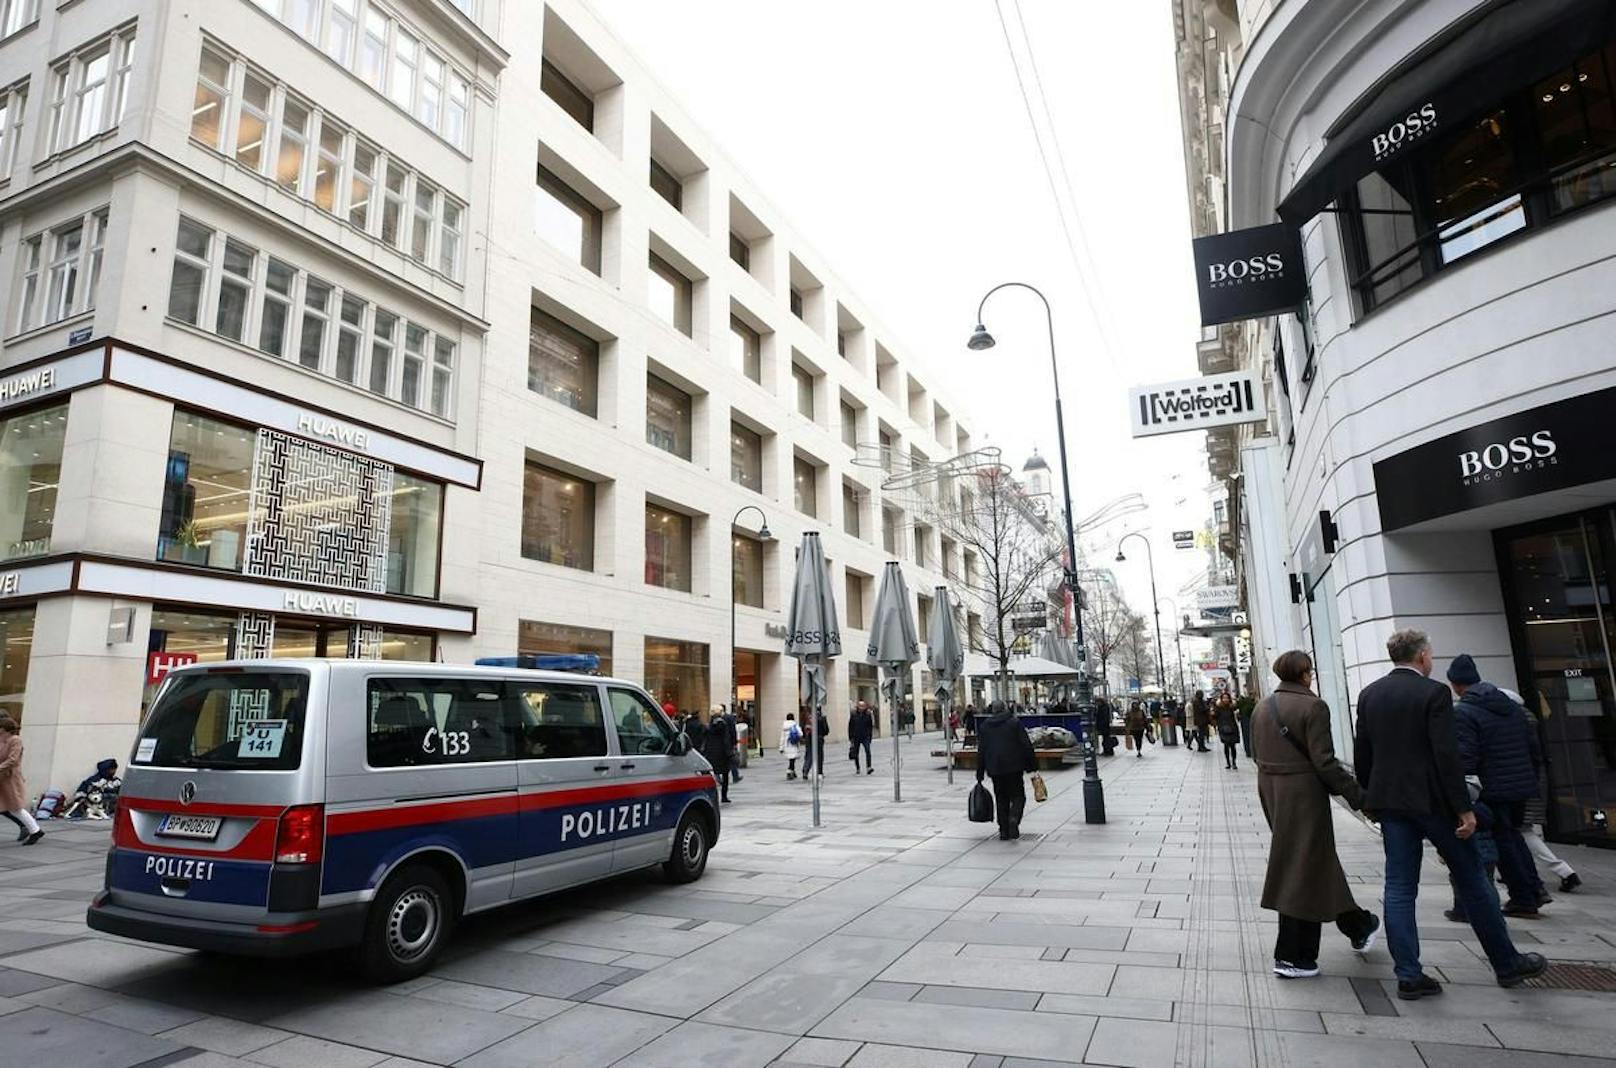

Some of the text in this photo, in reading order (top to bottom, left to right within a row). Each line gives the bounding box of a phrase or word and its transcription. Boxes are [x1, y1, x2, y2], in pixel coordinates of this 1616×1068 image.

[1372, 103, 1436, 156] BOSS
[1208, 253, 1283, 283] BOSS
[0, 367, 57, 399] HUAWEI
[1158, 389, 1233, 415] Wolford
[297, 412, 370, 449] HUAWEI
[1459, 429, 1558, 478] BOSS
[1463, 470, 1503, 487] HUGO
[283, 592, 361, 617] HUAWEI
[1563, 668, 1583, 678] EXIT
[247, 740, 273, 751] 141
[257, 729, 270, 739] U
[439, 731, 471, 756] 133
[560, 802, 651, 842] POLIZEI
[145, 855, 214, 881] POLIZEI
